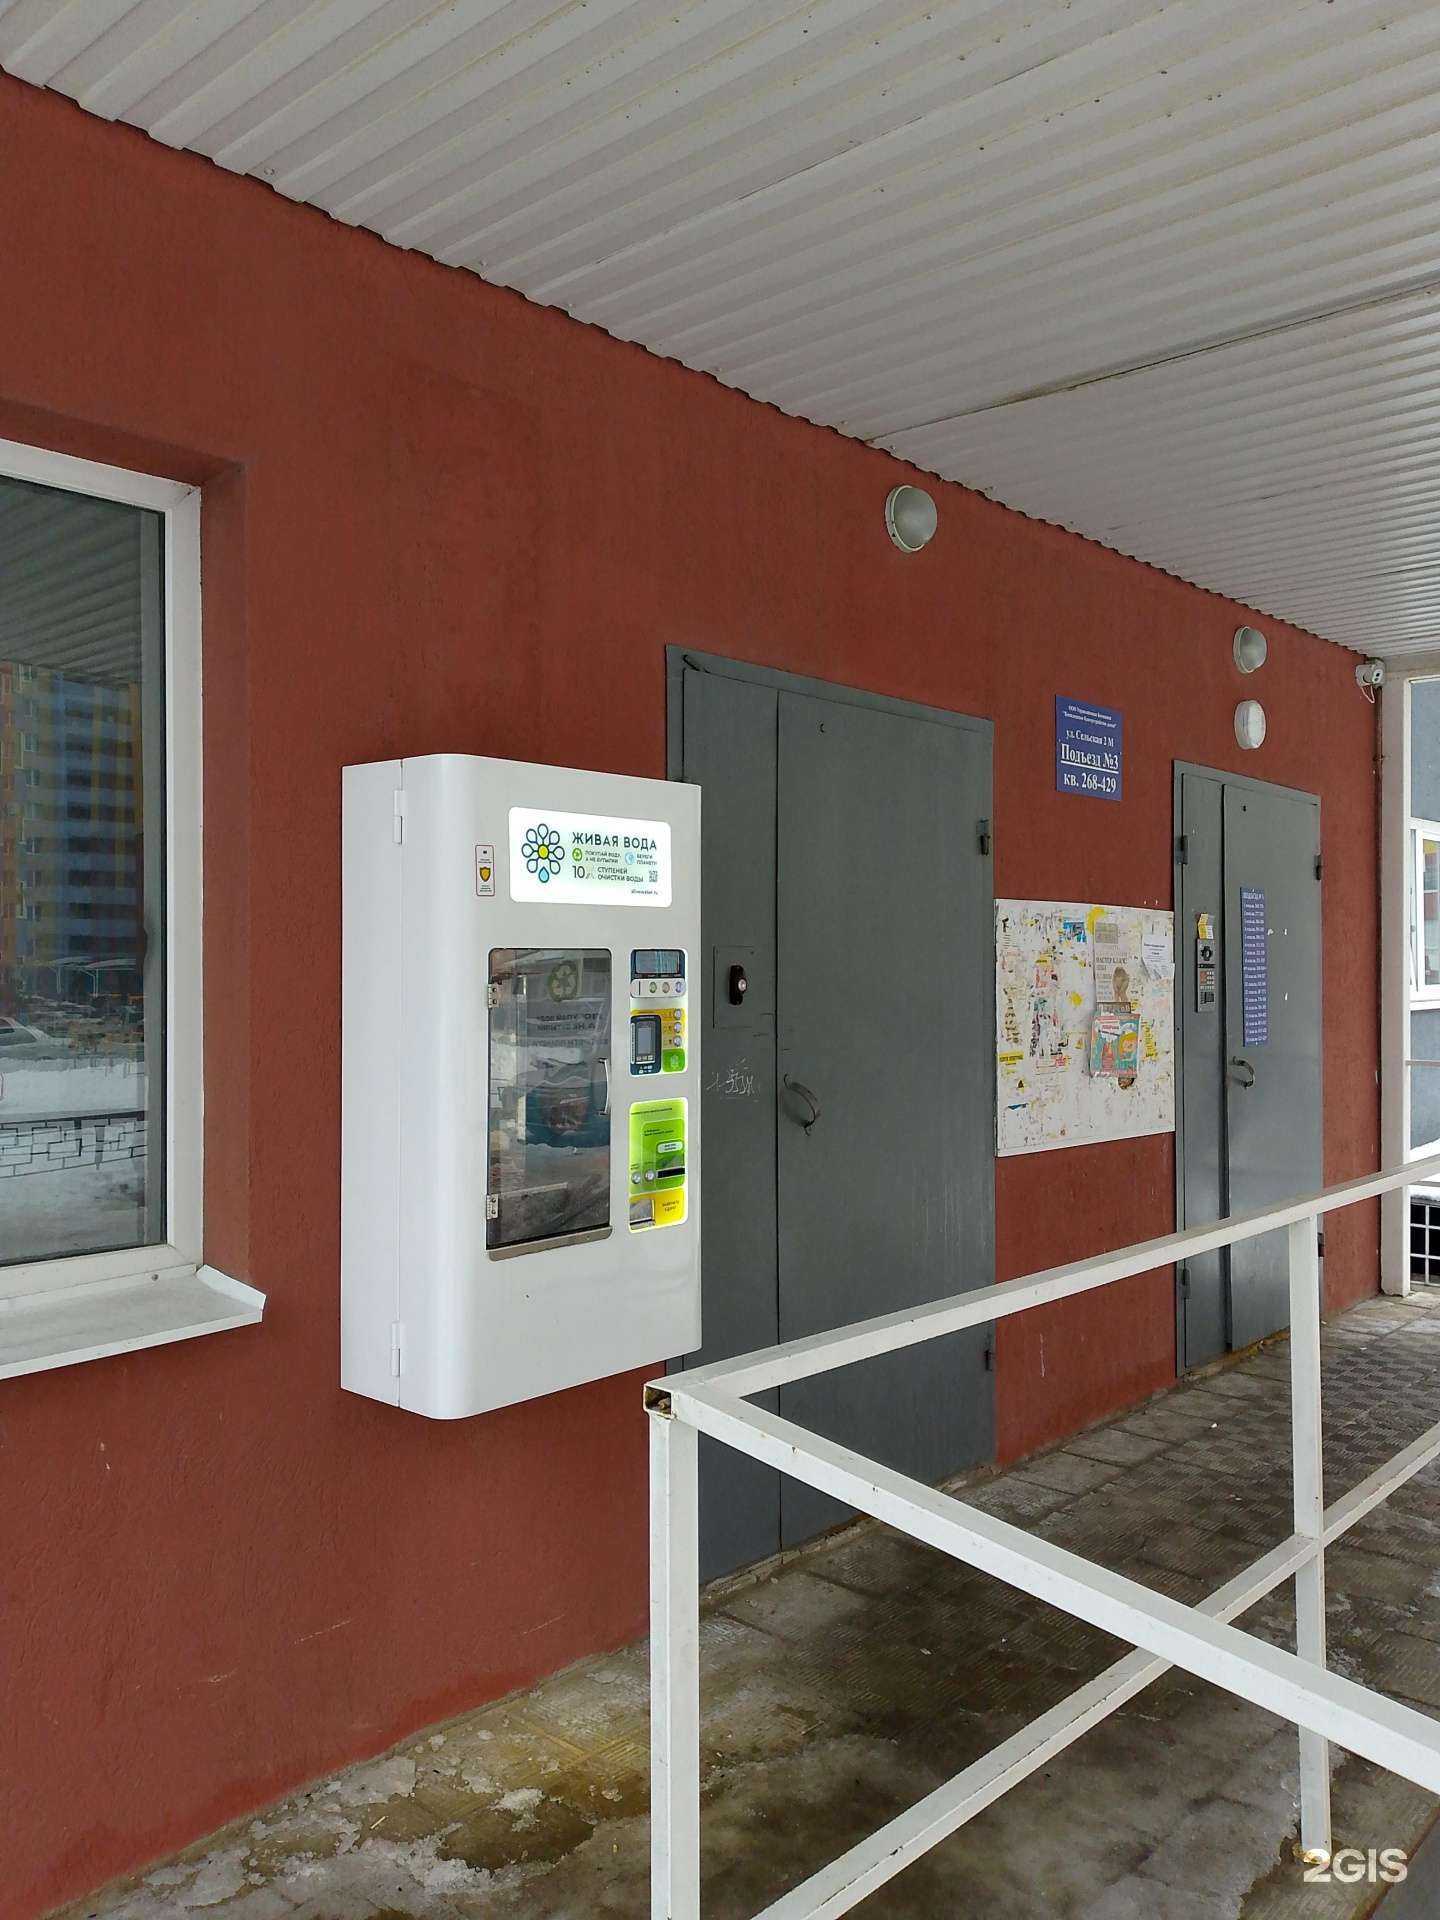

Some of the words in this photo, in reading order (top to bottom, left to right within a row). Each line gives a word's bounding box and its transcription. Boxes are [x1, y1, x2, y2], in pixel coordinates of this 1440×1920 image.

[1061, 743, 1101, 767] Подъезд
[1102, 752, 1119, 770] №3
[1063, 773, 1079, 787] кв.
[1081, 772, 1116, 793] 268-429
[572, 831, 619, 848] ЖИВАЯ
[623, 836, 657, 852] ВОДА
[572, 865, 586, 879] 10
[597, 866, 628, 875] СТУПЕНЕЙ
[597, 874, 626, 882] ОЧИСТКИ
[626, 875, 644, 883] ВОДЫ
